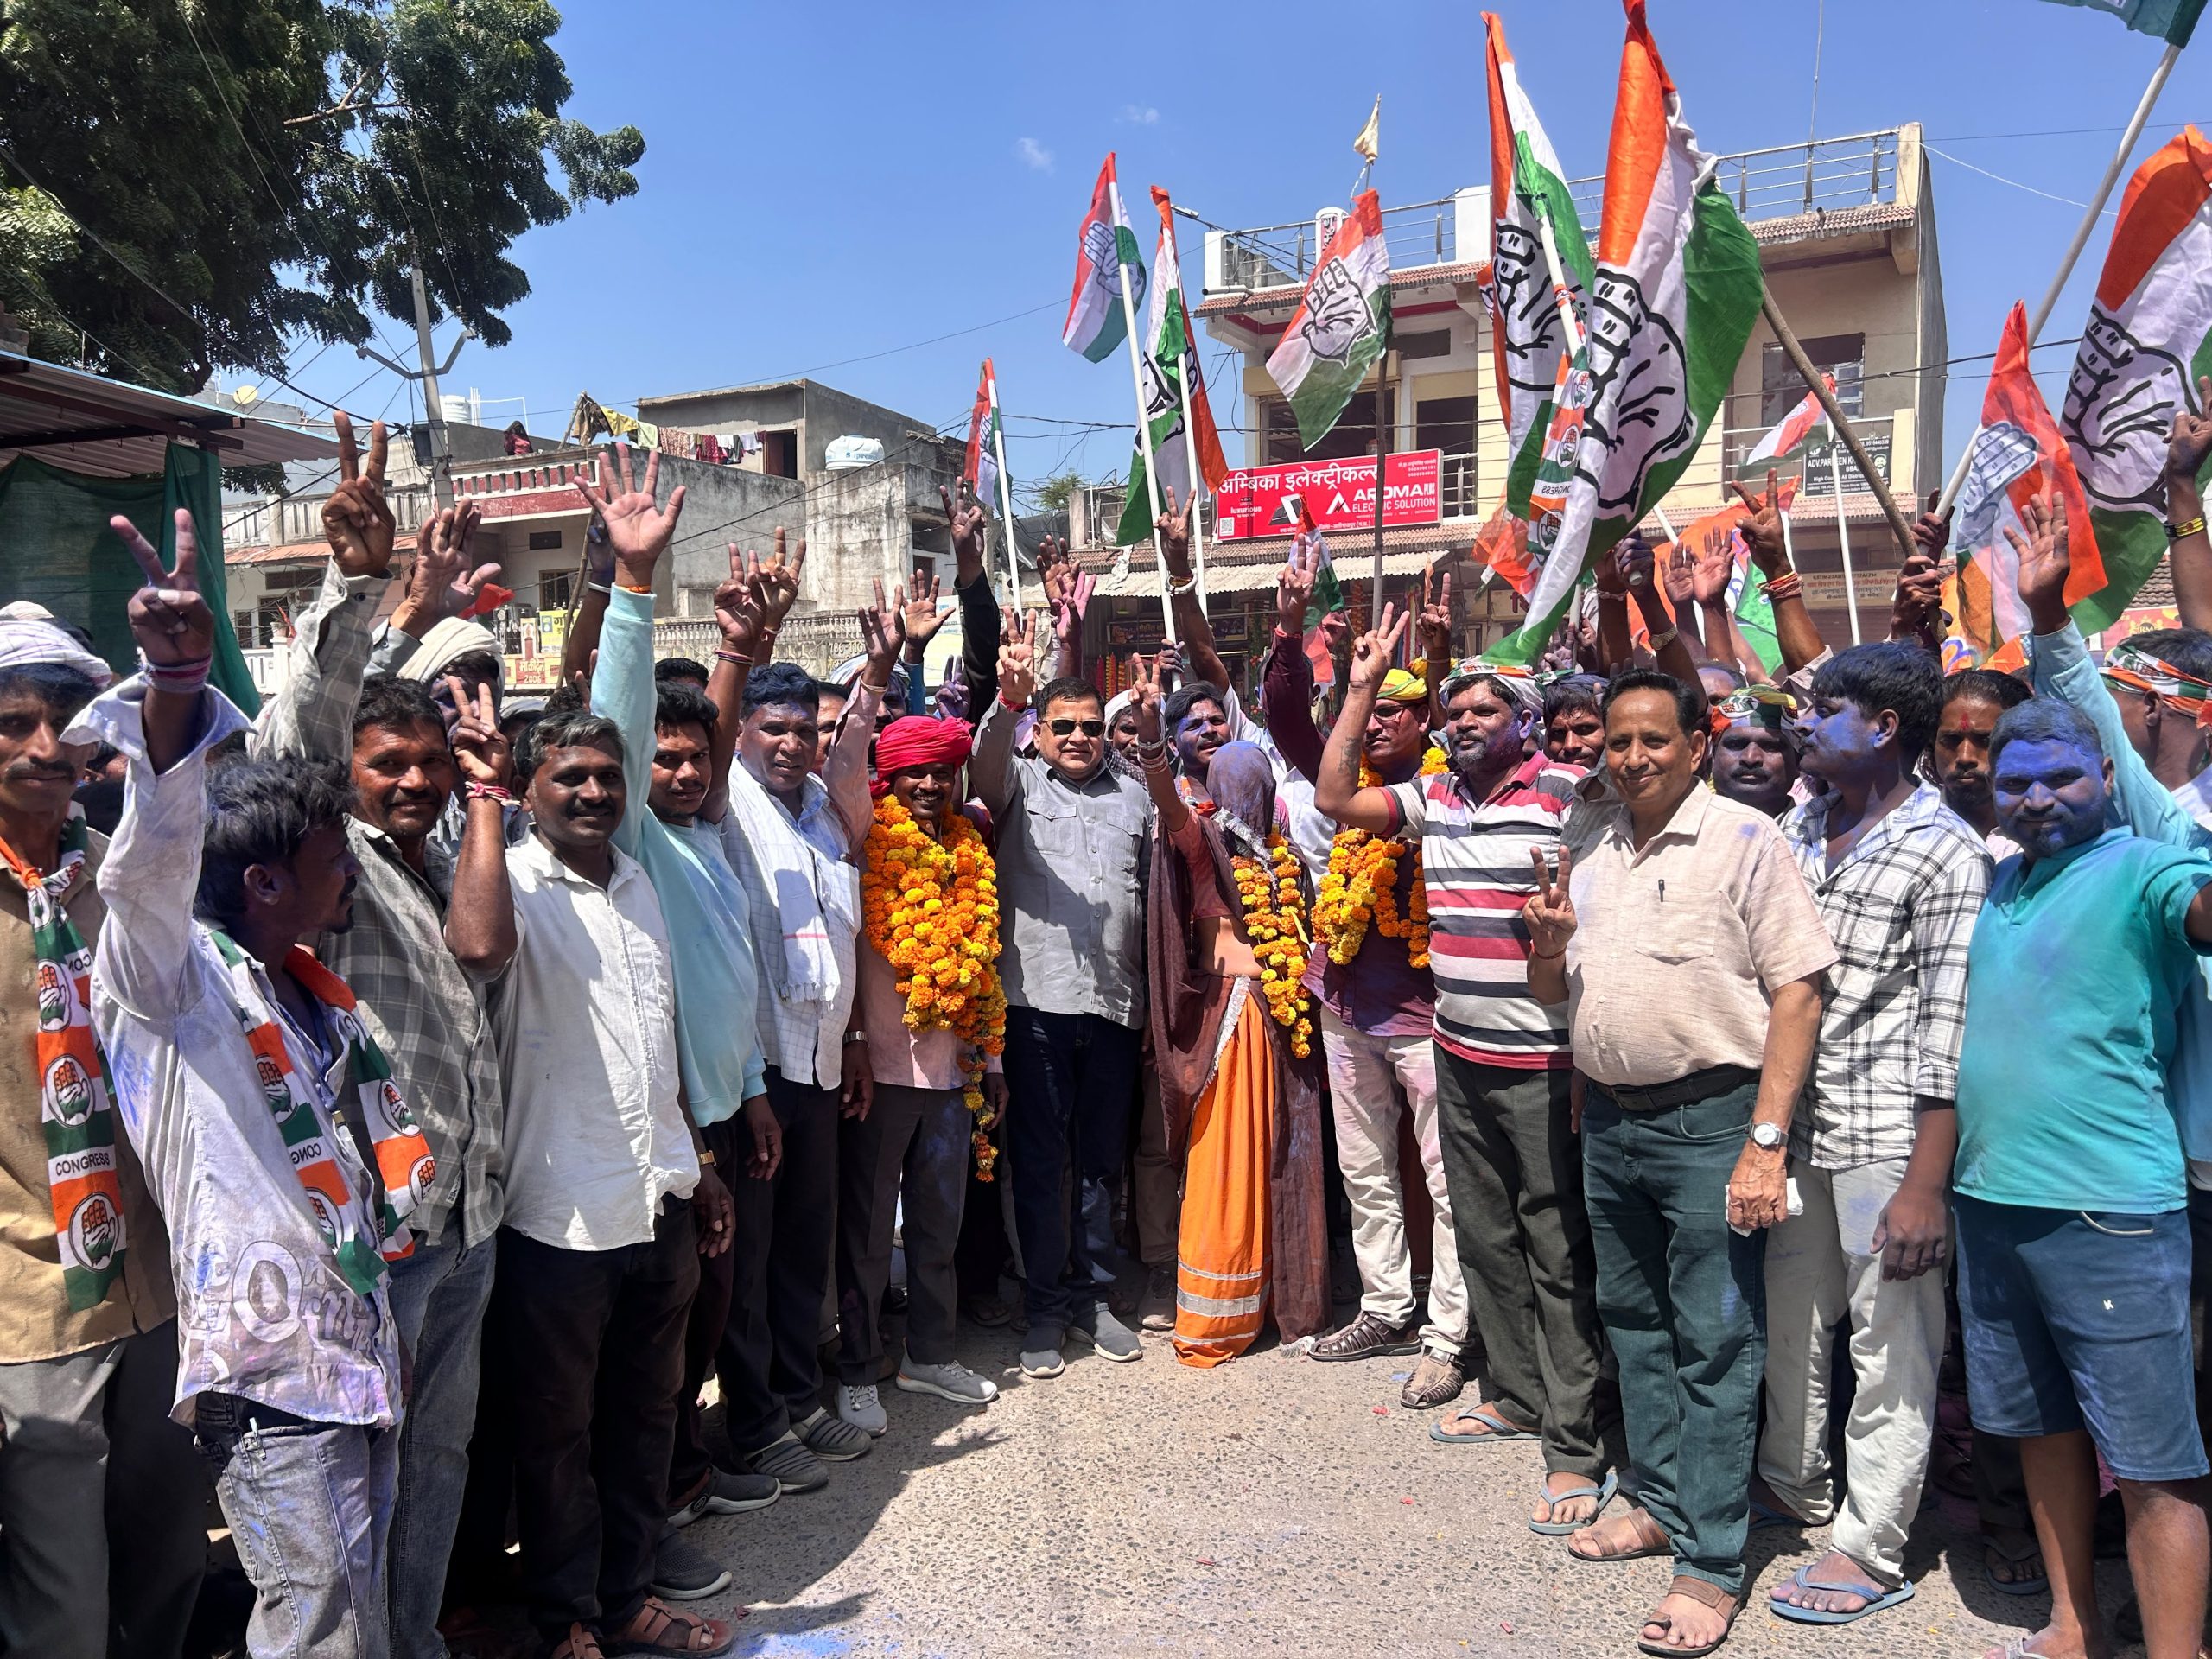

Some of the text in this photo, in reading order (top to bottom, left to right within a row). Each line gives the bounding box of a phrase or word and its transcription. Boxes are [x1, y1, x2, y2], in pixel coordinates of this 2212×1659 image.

[1808, 456, 1847, 467] ADV.PAREEN
[1219, 472, 1281, 493] अम्बिका
[1352, 498, 1436, 512] ELECIC SOLUTION
[55, 1152, 111, 1176] CONGRESS
